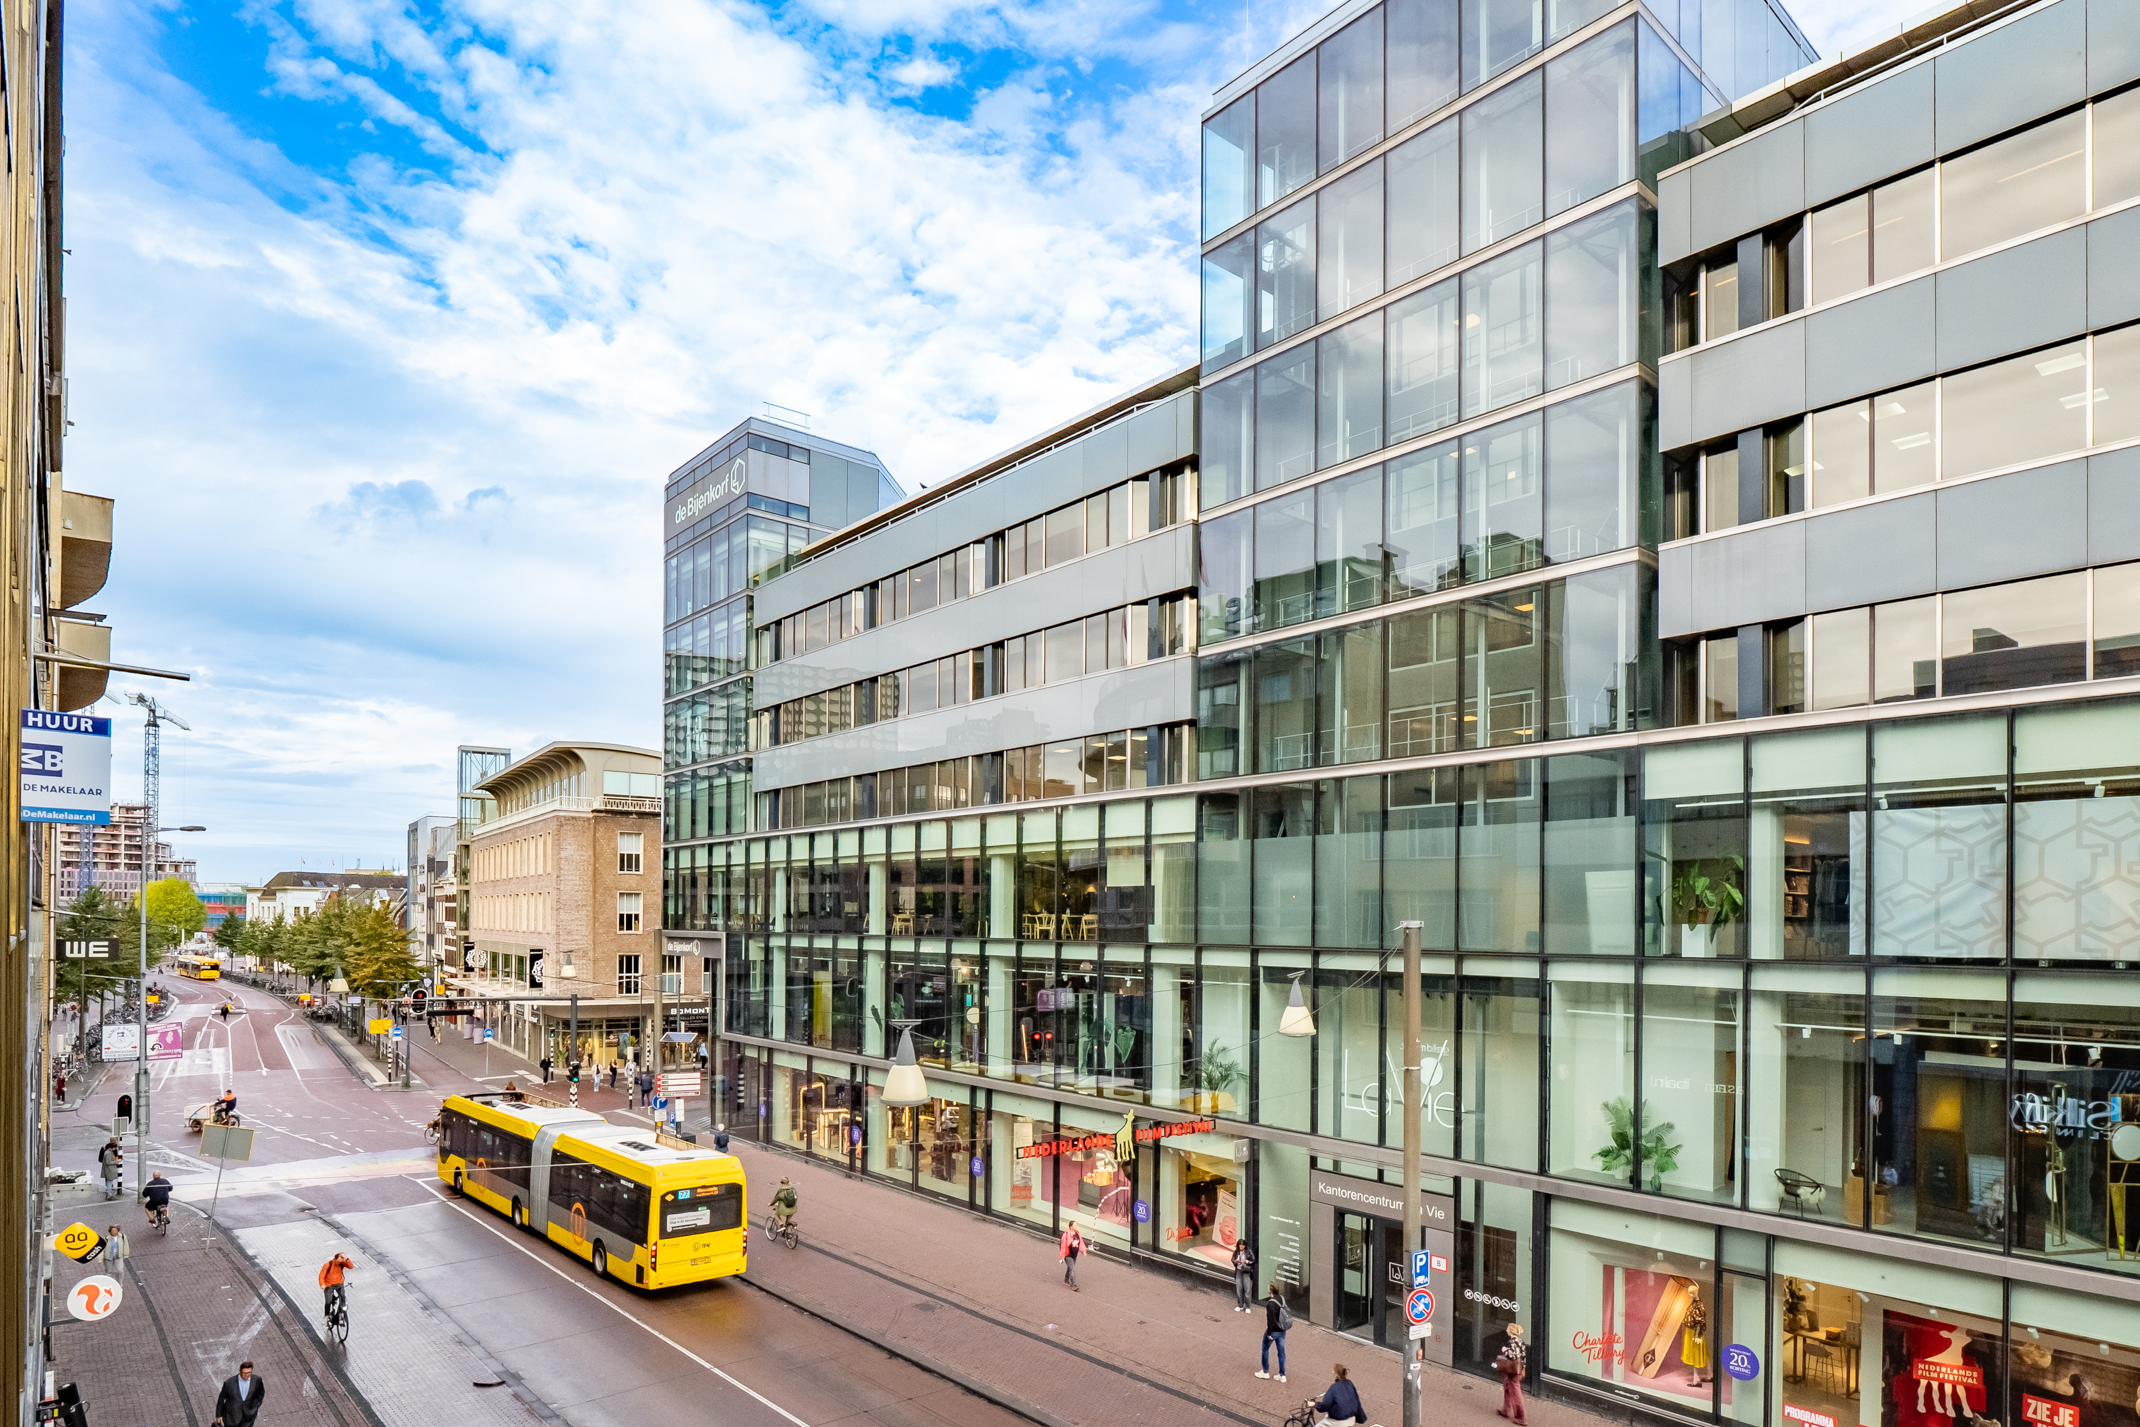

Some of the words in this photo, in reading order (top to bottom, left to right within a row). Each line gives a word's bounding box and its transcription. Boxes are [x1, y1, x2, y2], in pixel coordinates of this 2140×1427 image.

[675, 504, 686, 524] de
[688, 473, 729, 517] Bijenkorf
[28, 712, 93, 732] HUUR
[24, 784, 38, 792] DE
[40, 785, 102, 796] MAKELAAR
[21, 809, 96, 821] DeMakelaar.nl
[65, 941, 109, 958] WE
[670, 1114, 674, 1122] P
[1023, 1134, 1118, 1158] NEDERLANDS
[1136, 1126, 1162, 1142] FILM
[1164, 1120, 1212, 1138] FESTIVAL
[1318, 1182, 1404, 1211] Kantorencentrum
[1426, 1204, 1445, 1220] Vie
[86, 1246, 102, 1260] cash
[1416, 1254, 1426, 1273] P
[1572, 1330, 1622, 1350] Charlotte
[1582, 1346, 1625, 1365] Tilbury
[1918, 1363, 1978, 1378] NEDERLANDS
[1918, 1370, 1938, 1378] FILM
[1940, 1373, 1978, 1384] FESTIVAL
[1784, 1404, 1834, 1427] PROGRAMMA
[2026, 1398, 2052, 1423] ZIE
[2054, 1406, 2074, 1427] JE
